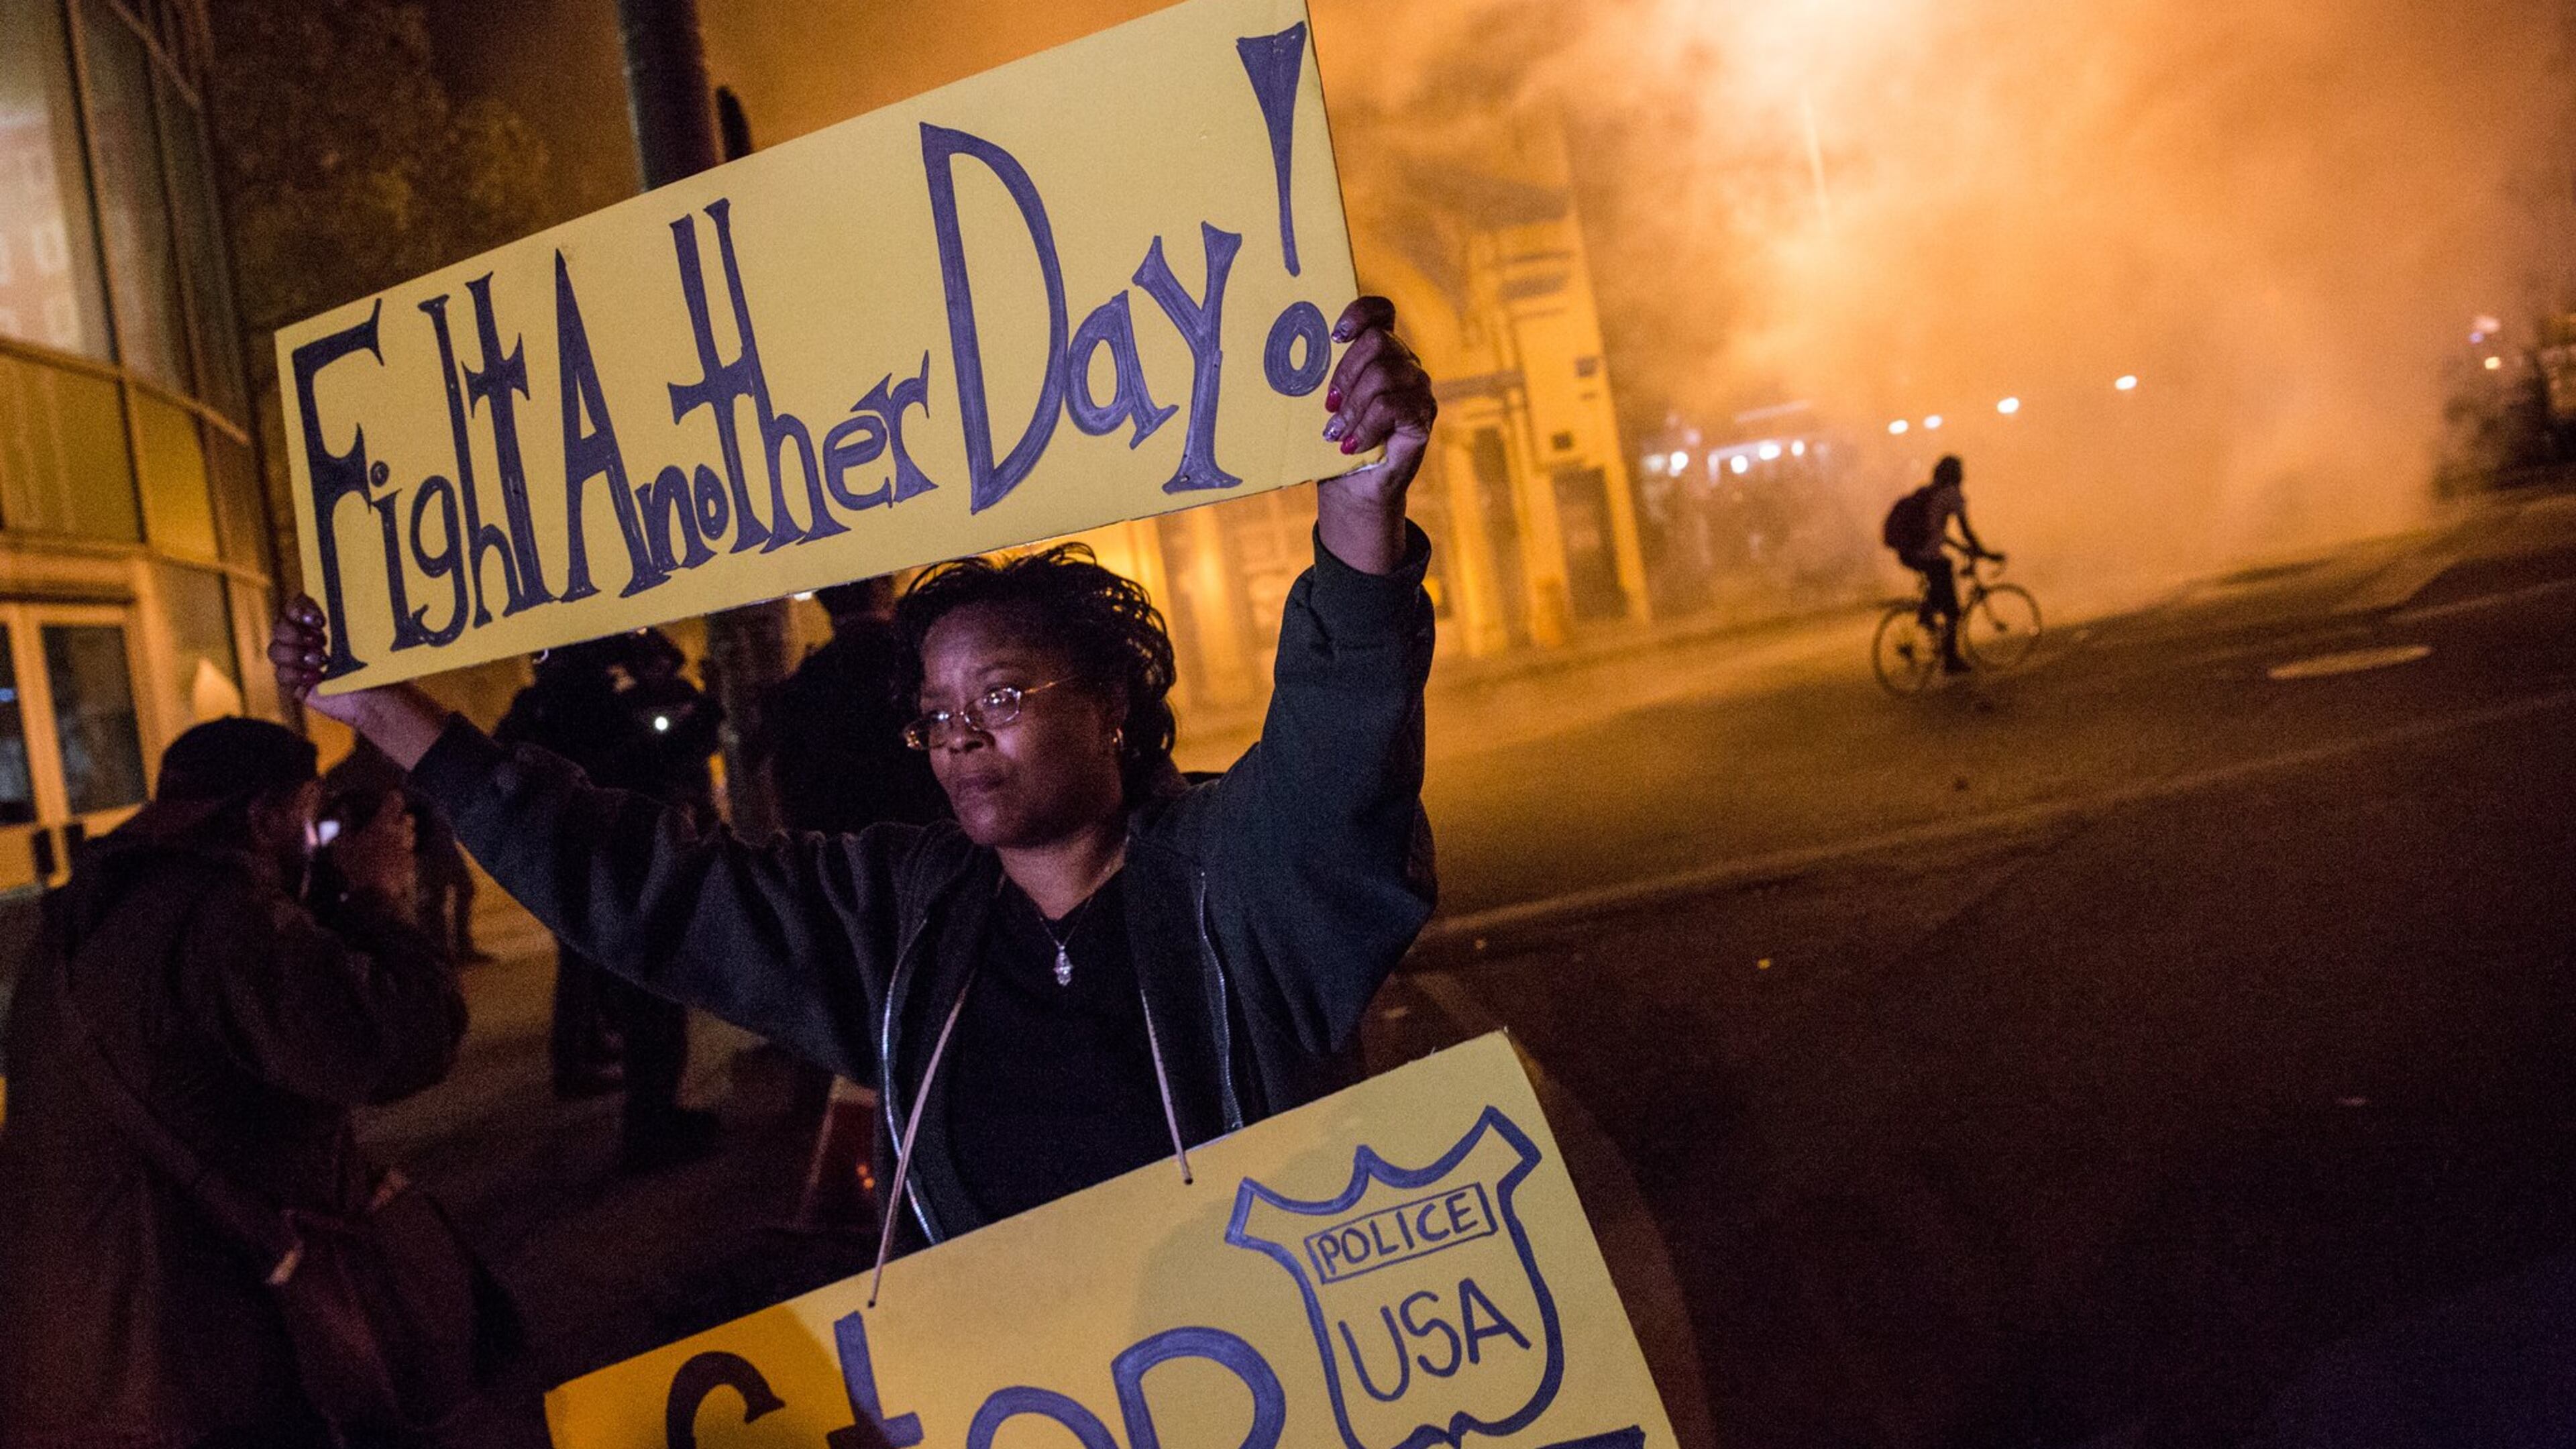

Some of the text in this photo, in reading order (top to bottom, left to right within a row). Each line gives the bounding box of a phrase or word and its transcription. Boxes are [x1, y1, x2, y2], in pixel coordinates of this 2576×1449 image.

[292, 270, 558, 678] Fight
[555, 198, 938, 597] Another
[1318, 1192, 1479, 1274] POLICE
[1339, 1279, 1531, 1401] USA
